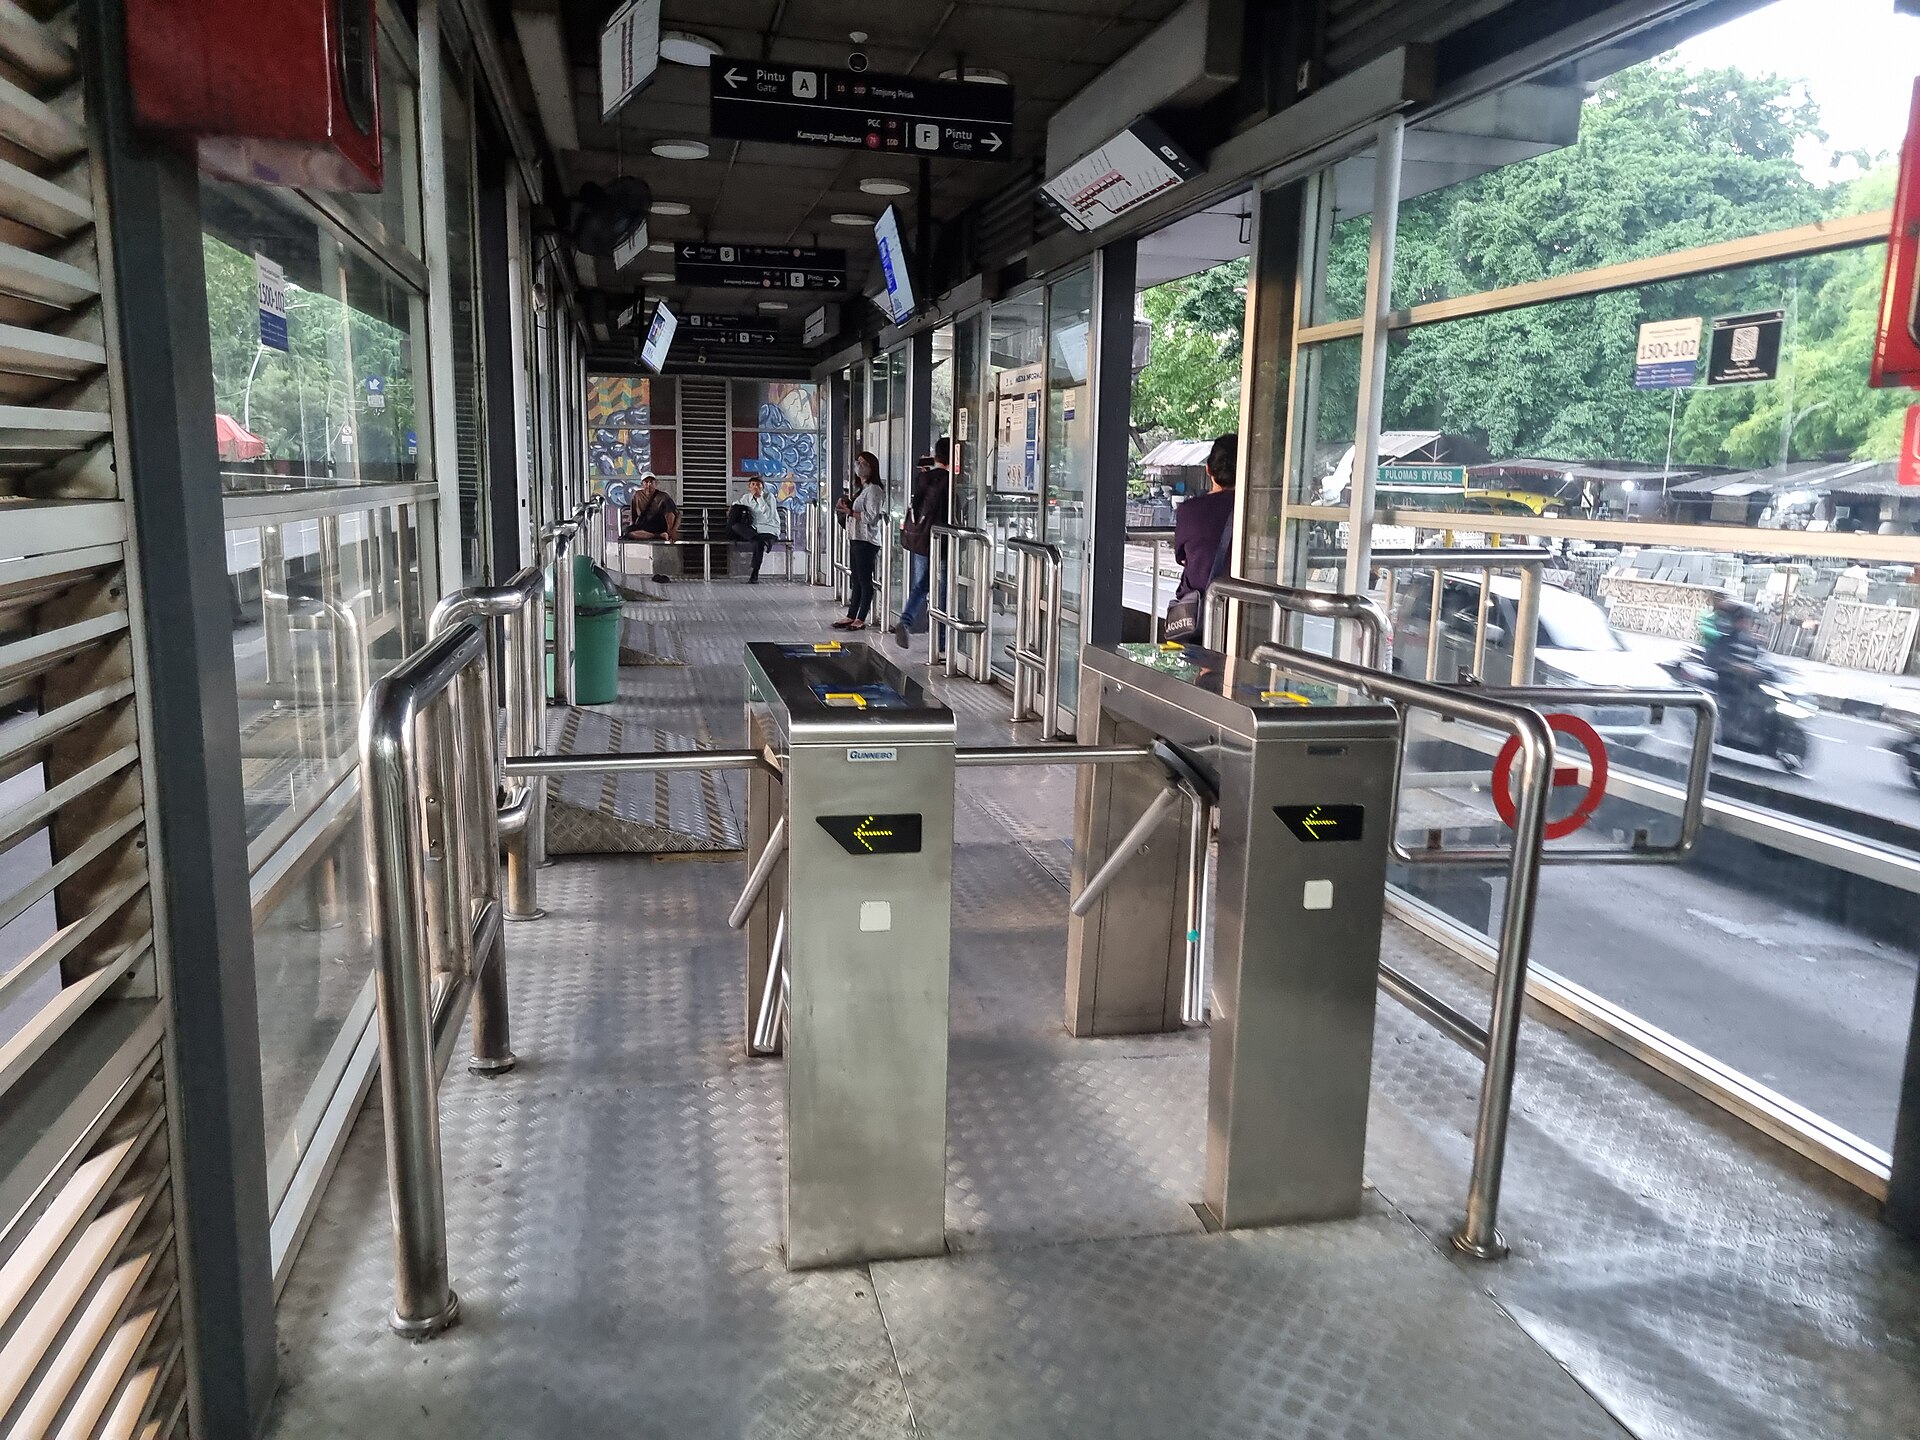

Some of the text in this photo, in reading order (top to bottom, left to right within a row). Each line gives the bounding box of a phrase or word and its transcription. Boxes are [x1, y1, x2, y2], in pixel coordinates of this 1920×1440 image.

[756, 69, 785, 82] Pintu
[756, 82, 777, 93] Gate
[799, 78, 810, 91] A
[871, 86, 897, 99] Tanjung
[867, 118, 881, 128] PGC
[797, 130, 828, 143] Kampung
[828, 132, 862, 144] Rambutan
[923, 130, 931, 143] F
[945, 128, 972, 140] Pintu
[953, 140, 973, 151] Gate
[1640, 339, 1697, 360] 1500-102
[1385, 469, 1418, 481] PULOMAS
[1421, 470, 1432, 481] BY
[1433, 470, 1453, 482] PASS
[850, 750, 893, 760] GUNNEBO
